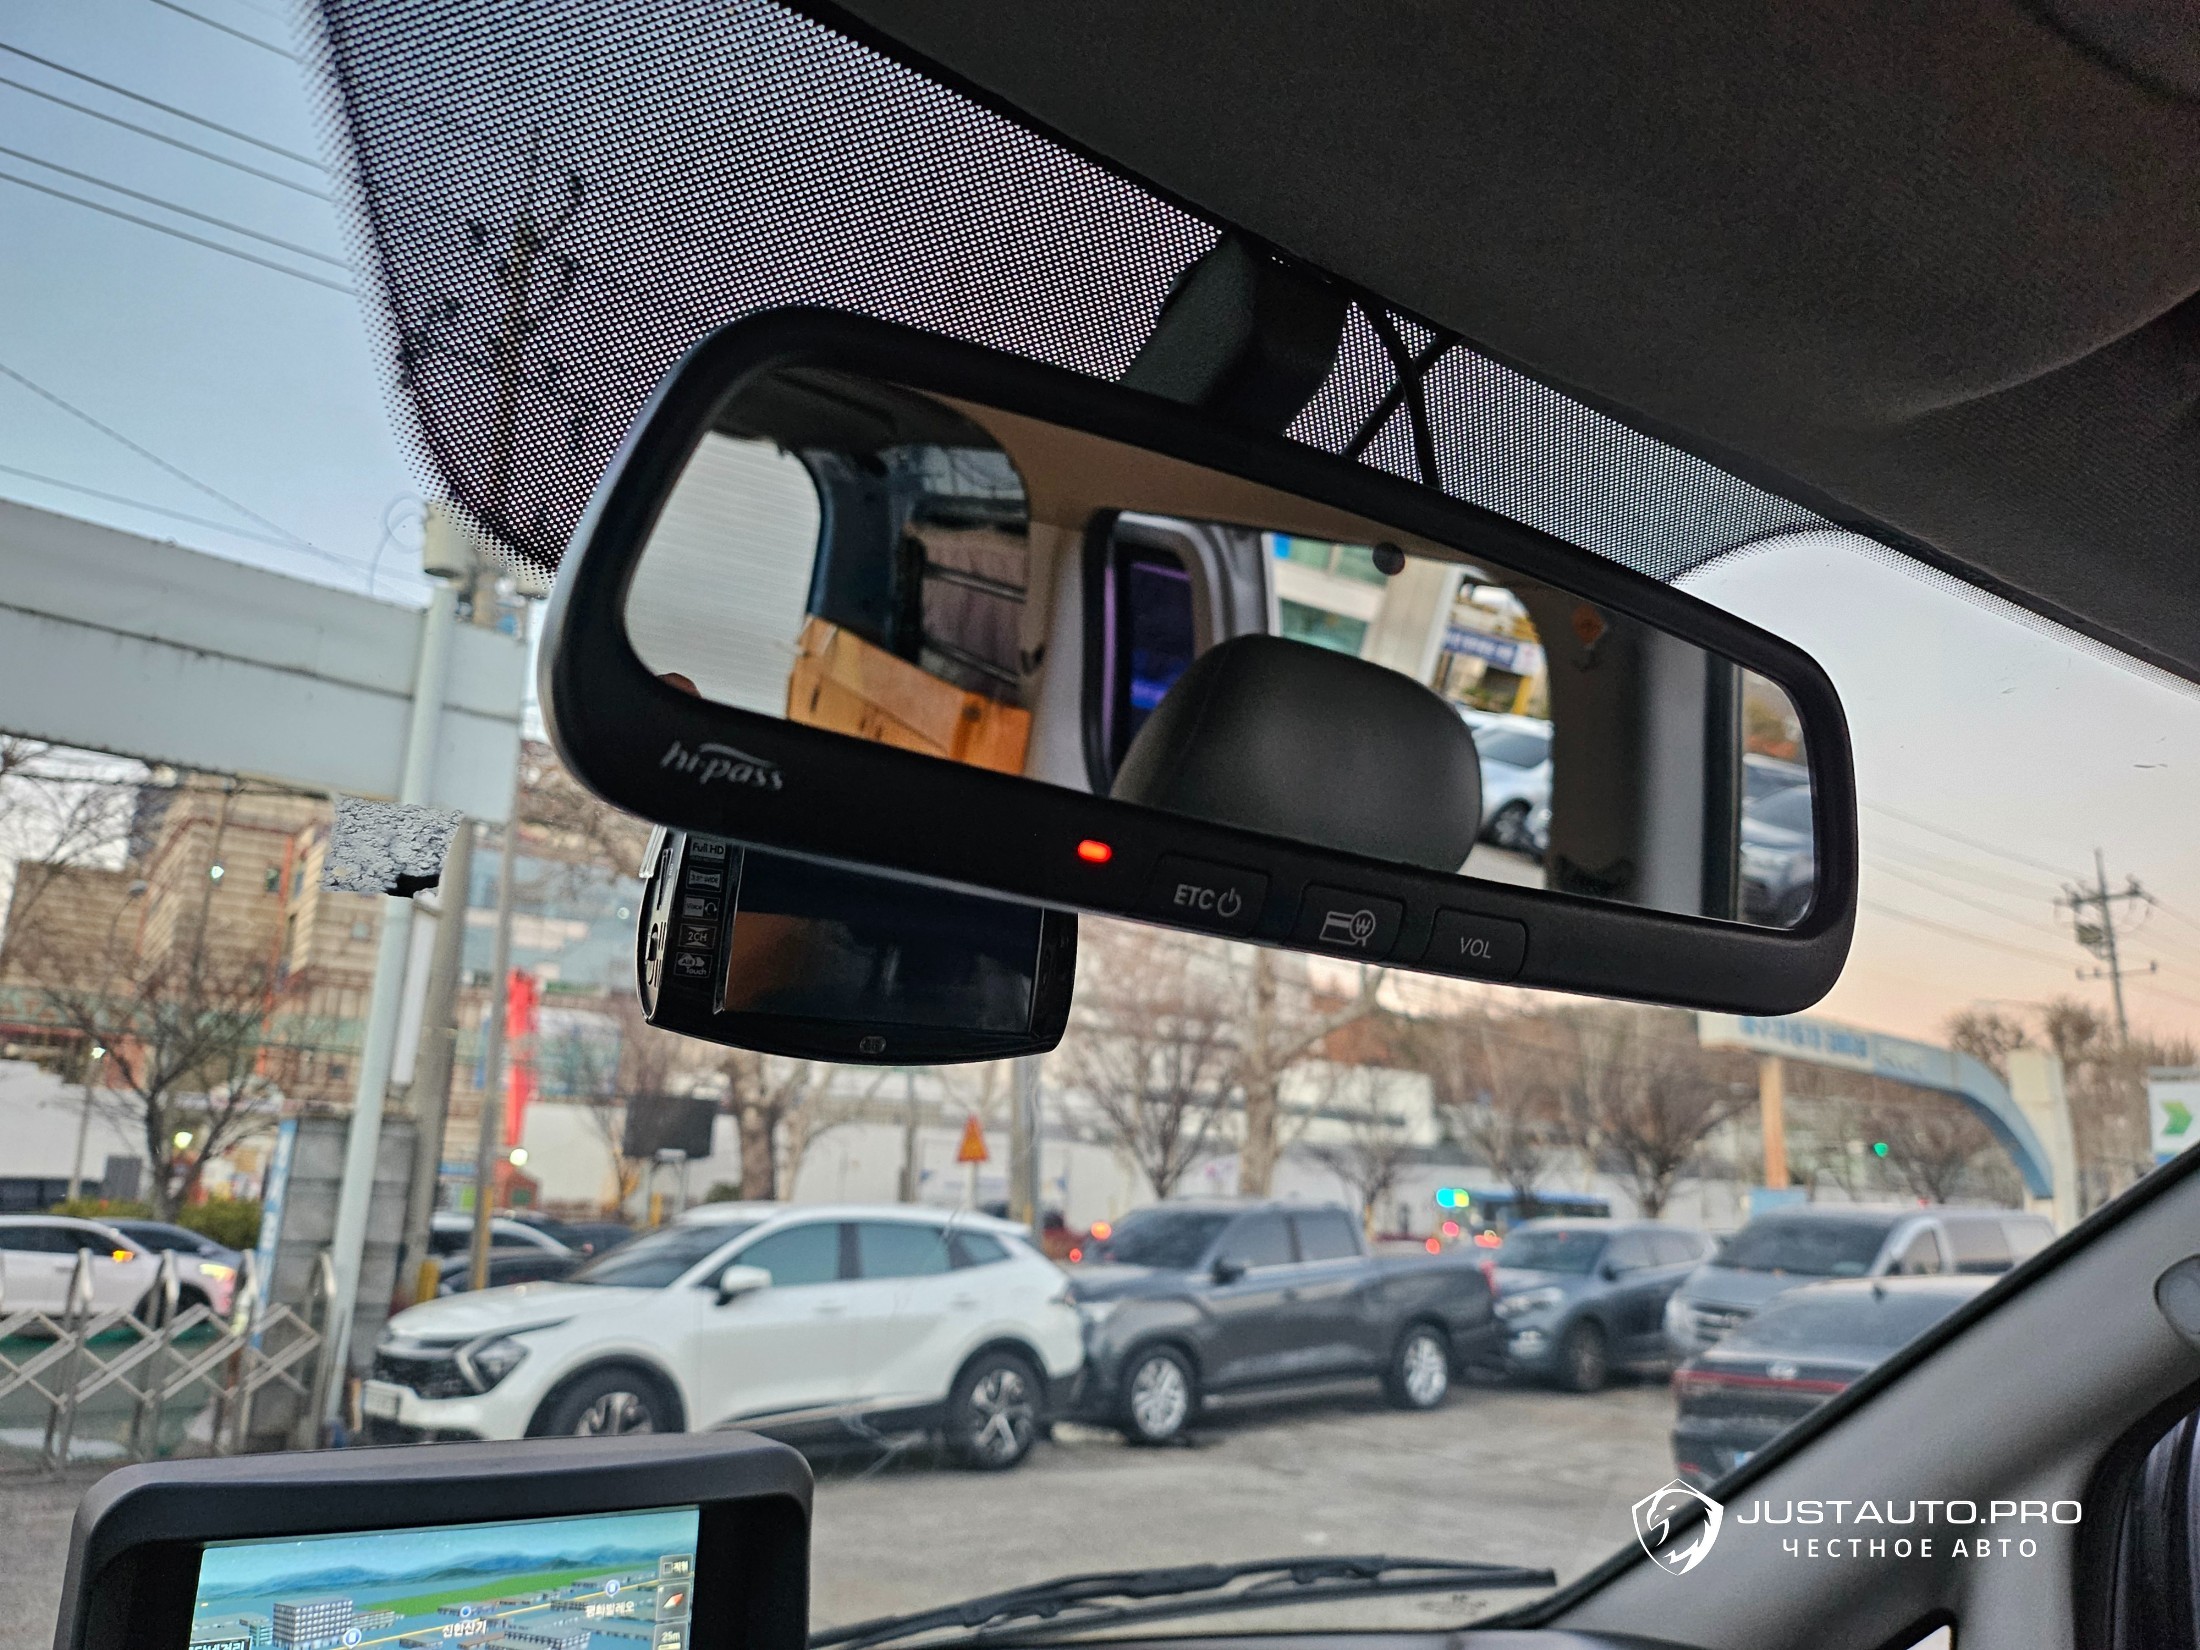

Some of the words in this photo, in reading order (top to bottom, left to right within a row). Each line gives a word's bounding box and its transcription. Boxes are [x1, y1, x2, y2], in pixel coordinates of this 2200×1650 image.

[692, 842, 708, 853] Full
[709, 844, 724, 855] HD
[1174, 884, 1215, 910] ETC
[688, 931, 708, 942] 2CH
[1461, 937, 1491, 958] VOL
[686, 966, 707, 976] Touch
